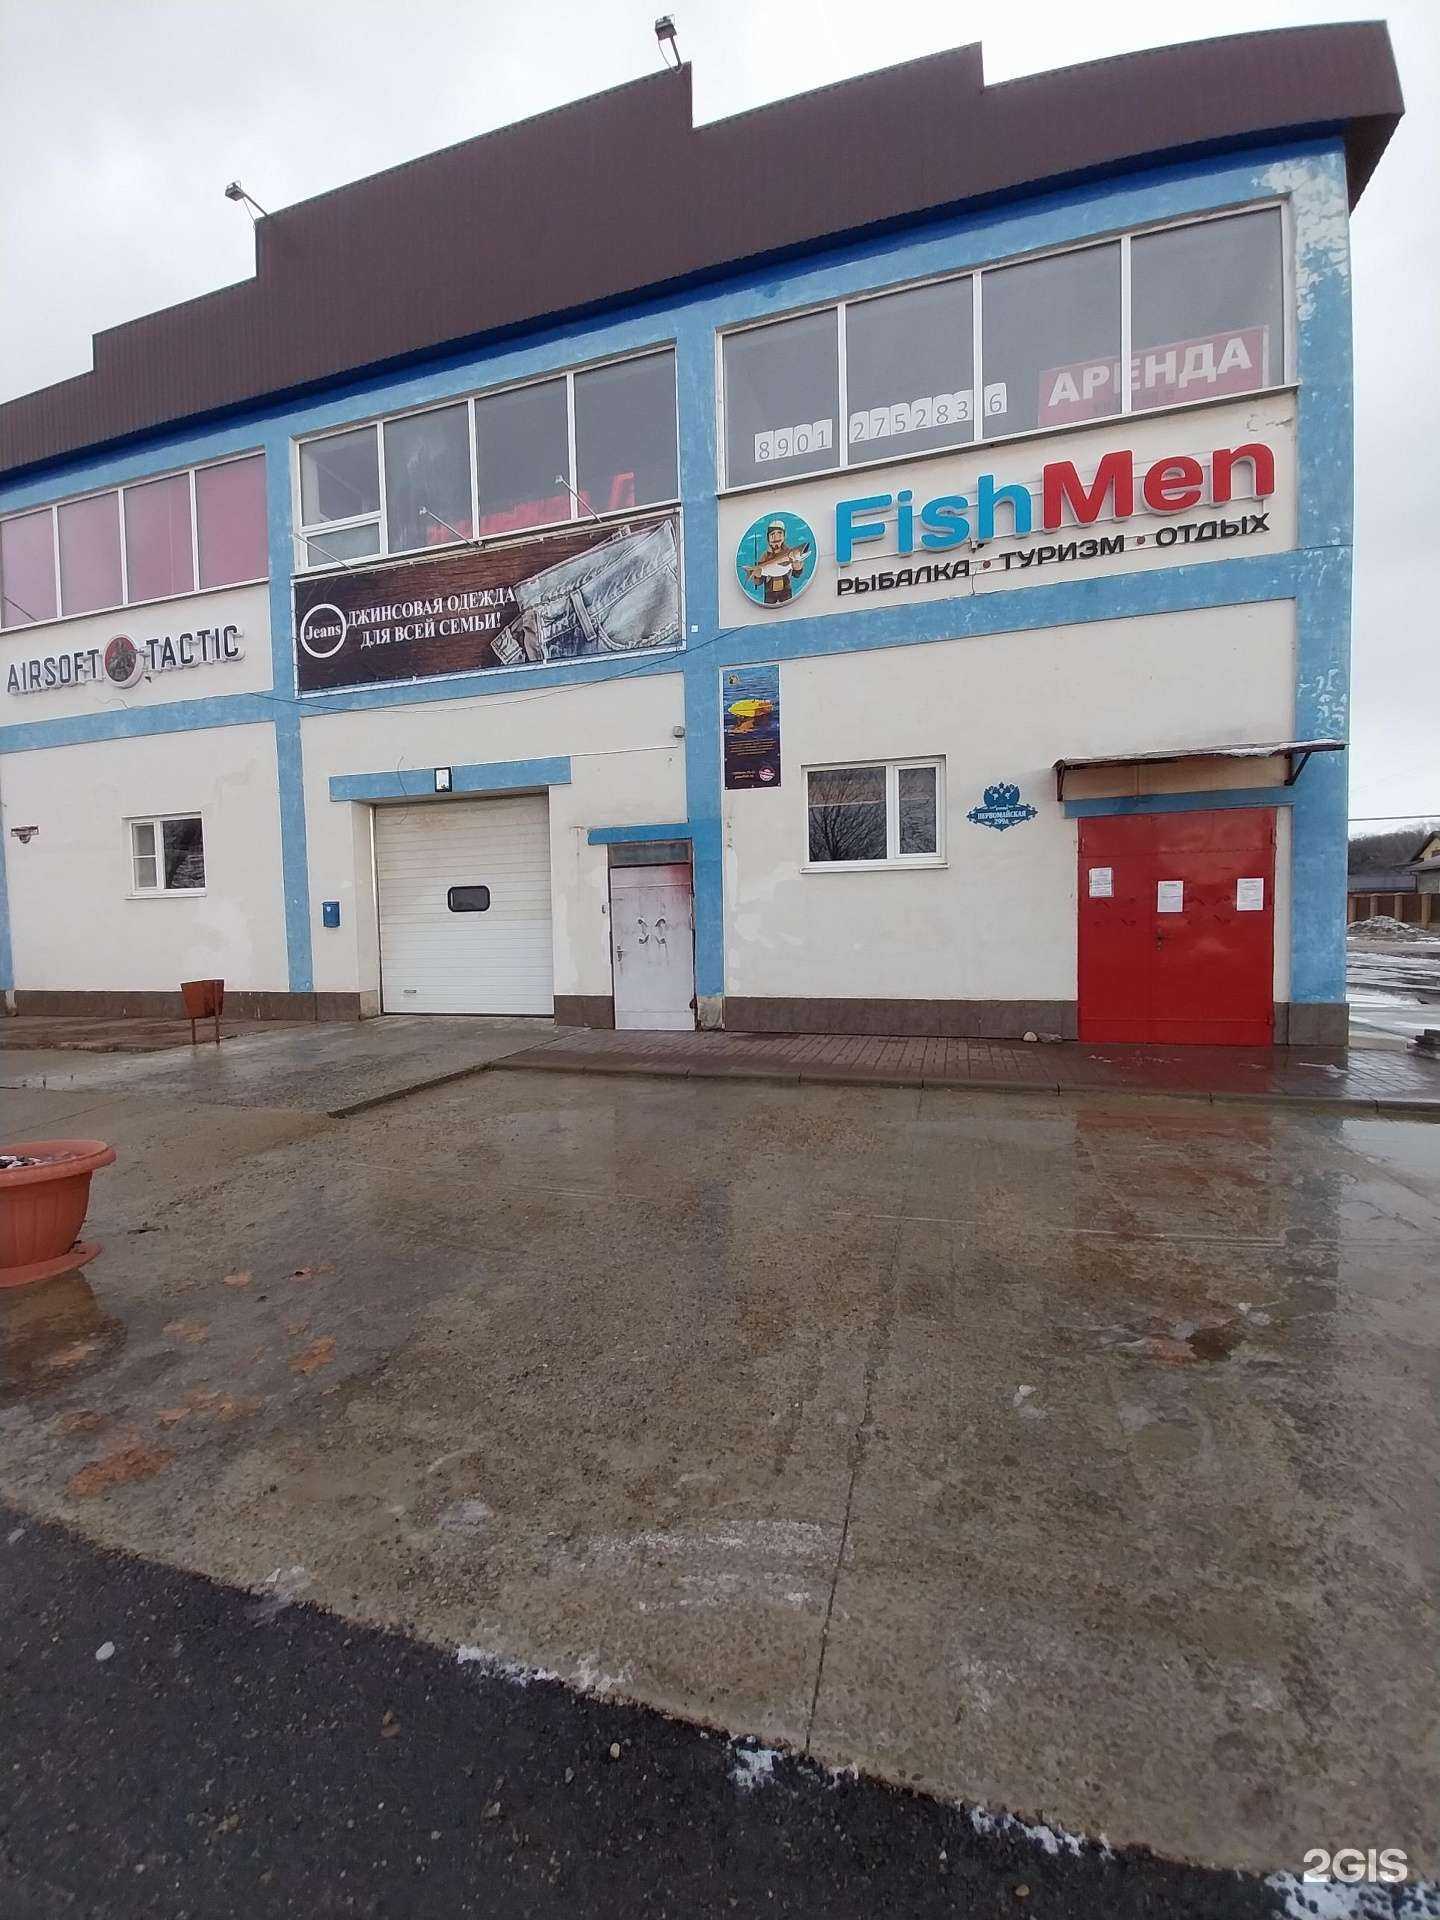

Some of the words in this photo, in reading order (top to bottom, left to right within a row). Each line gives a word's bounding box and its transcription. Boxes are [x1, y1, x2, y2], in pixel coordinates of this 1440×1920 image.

[1048, 337, 1252, 407] АРЕНДА
[835, 443, 1275, 564] FishMen
[837, 560, 970, 596] РЫБАЛКА
[999, 535, 1125, 570] ТУРИЗМ
[1156, 512, 1270, 547] ОТДЫХ
[305, 624, 342, 640] Jeans
[347, 597, 443, 628] ДЖИНСОВАЯ
[447, 586, 516, 613] ОДЕЖДА
[361, 627, 390, 650] ДЛЯ
[394, 618, 435, 642] ВСЕЙ
[439, 611, 502, 637] СЕМЬИ!
[7, 648, 100, 693] AIRSOFT
[146, 625, 240, 669] TACTIC
